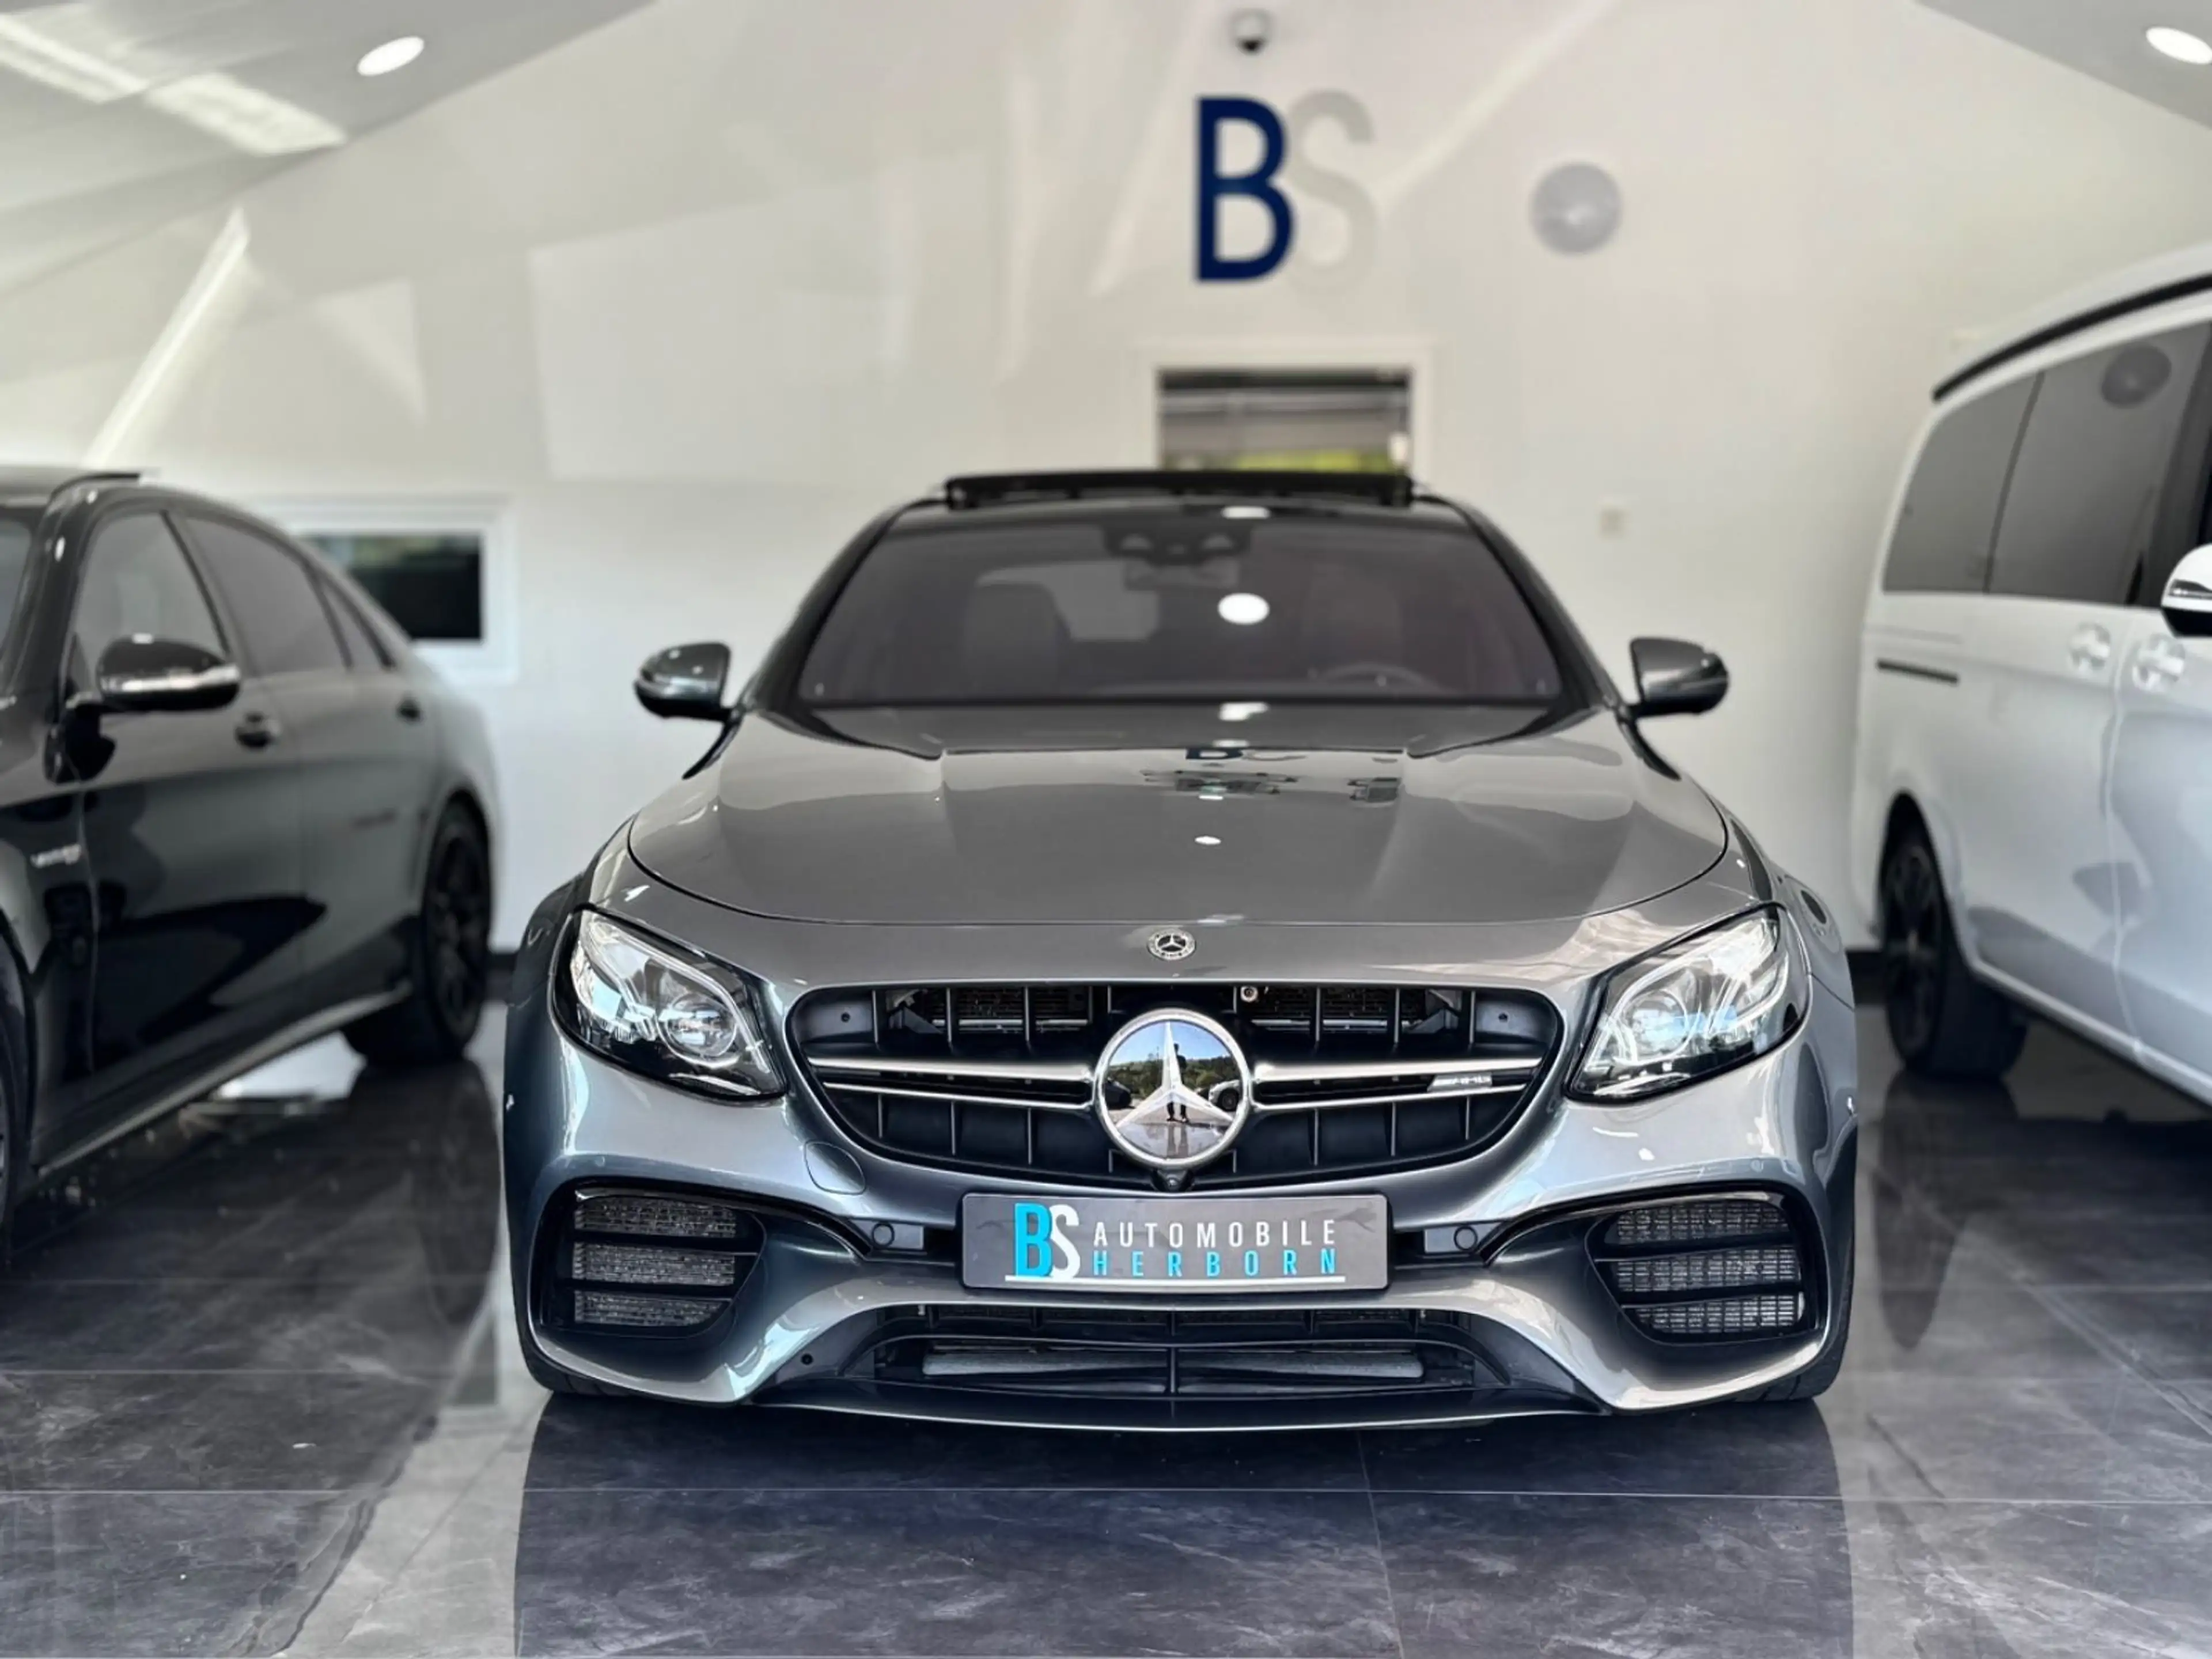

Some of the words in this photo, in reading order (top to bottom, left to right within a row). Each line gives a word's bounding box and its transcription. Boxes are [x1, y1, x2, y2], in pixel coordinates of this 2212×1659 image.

[1192, 89, 1378, 295] BS
[1014, 1202, 1080, 1281] BS
[1093, 1219, 1336, 1248] AUTOMOBILE
[1093, 1248, 1336, 1277] HERBORN
